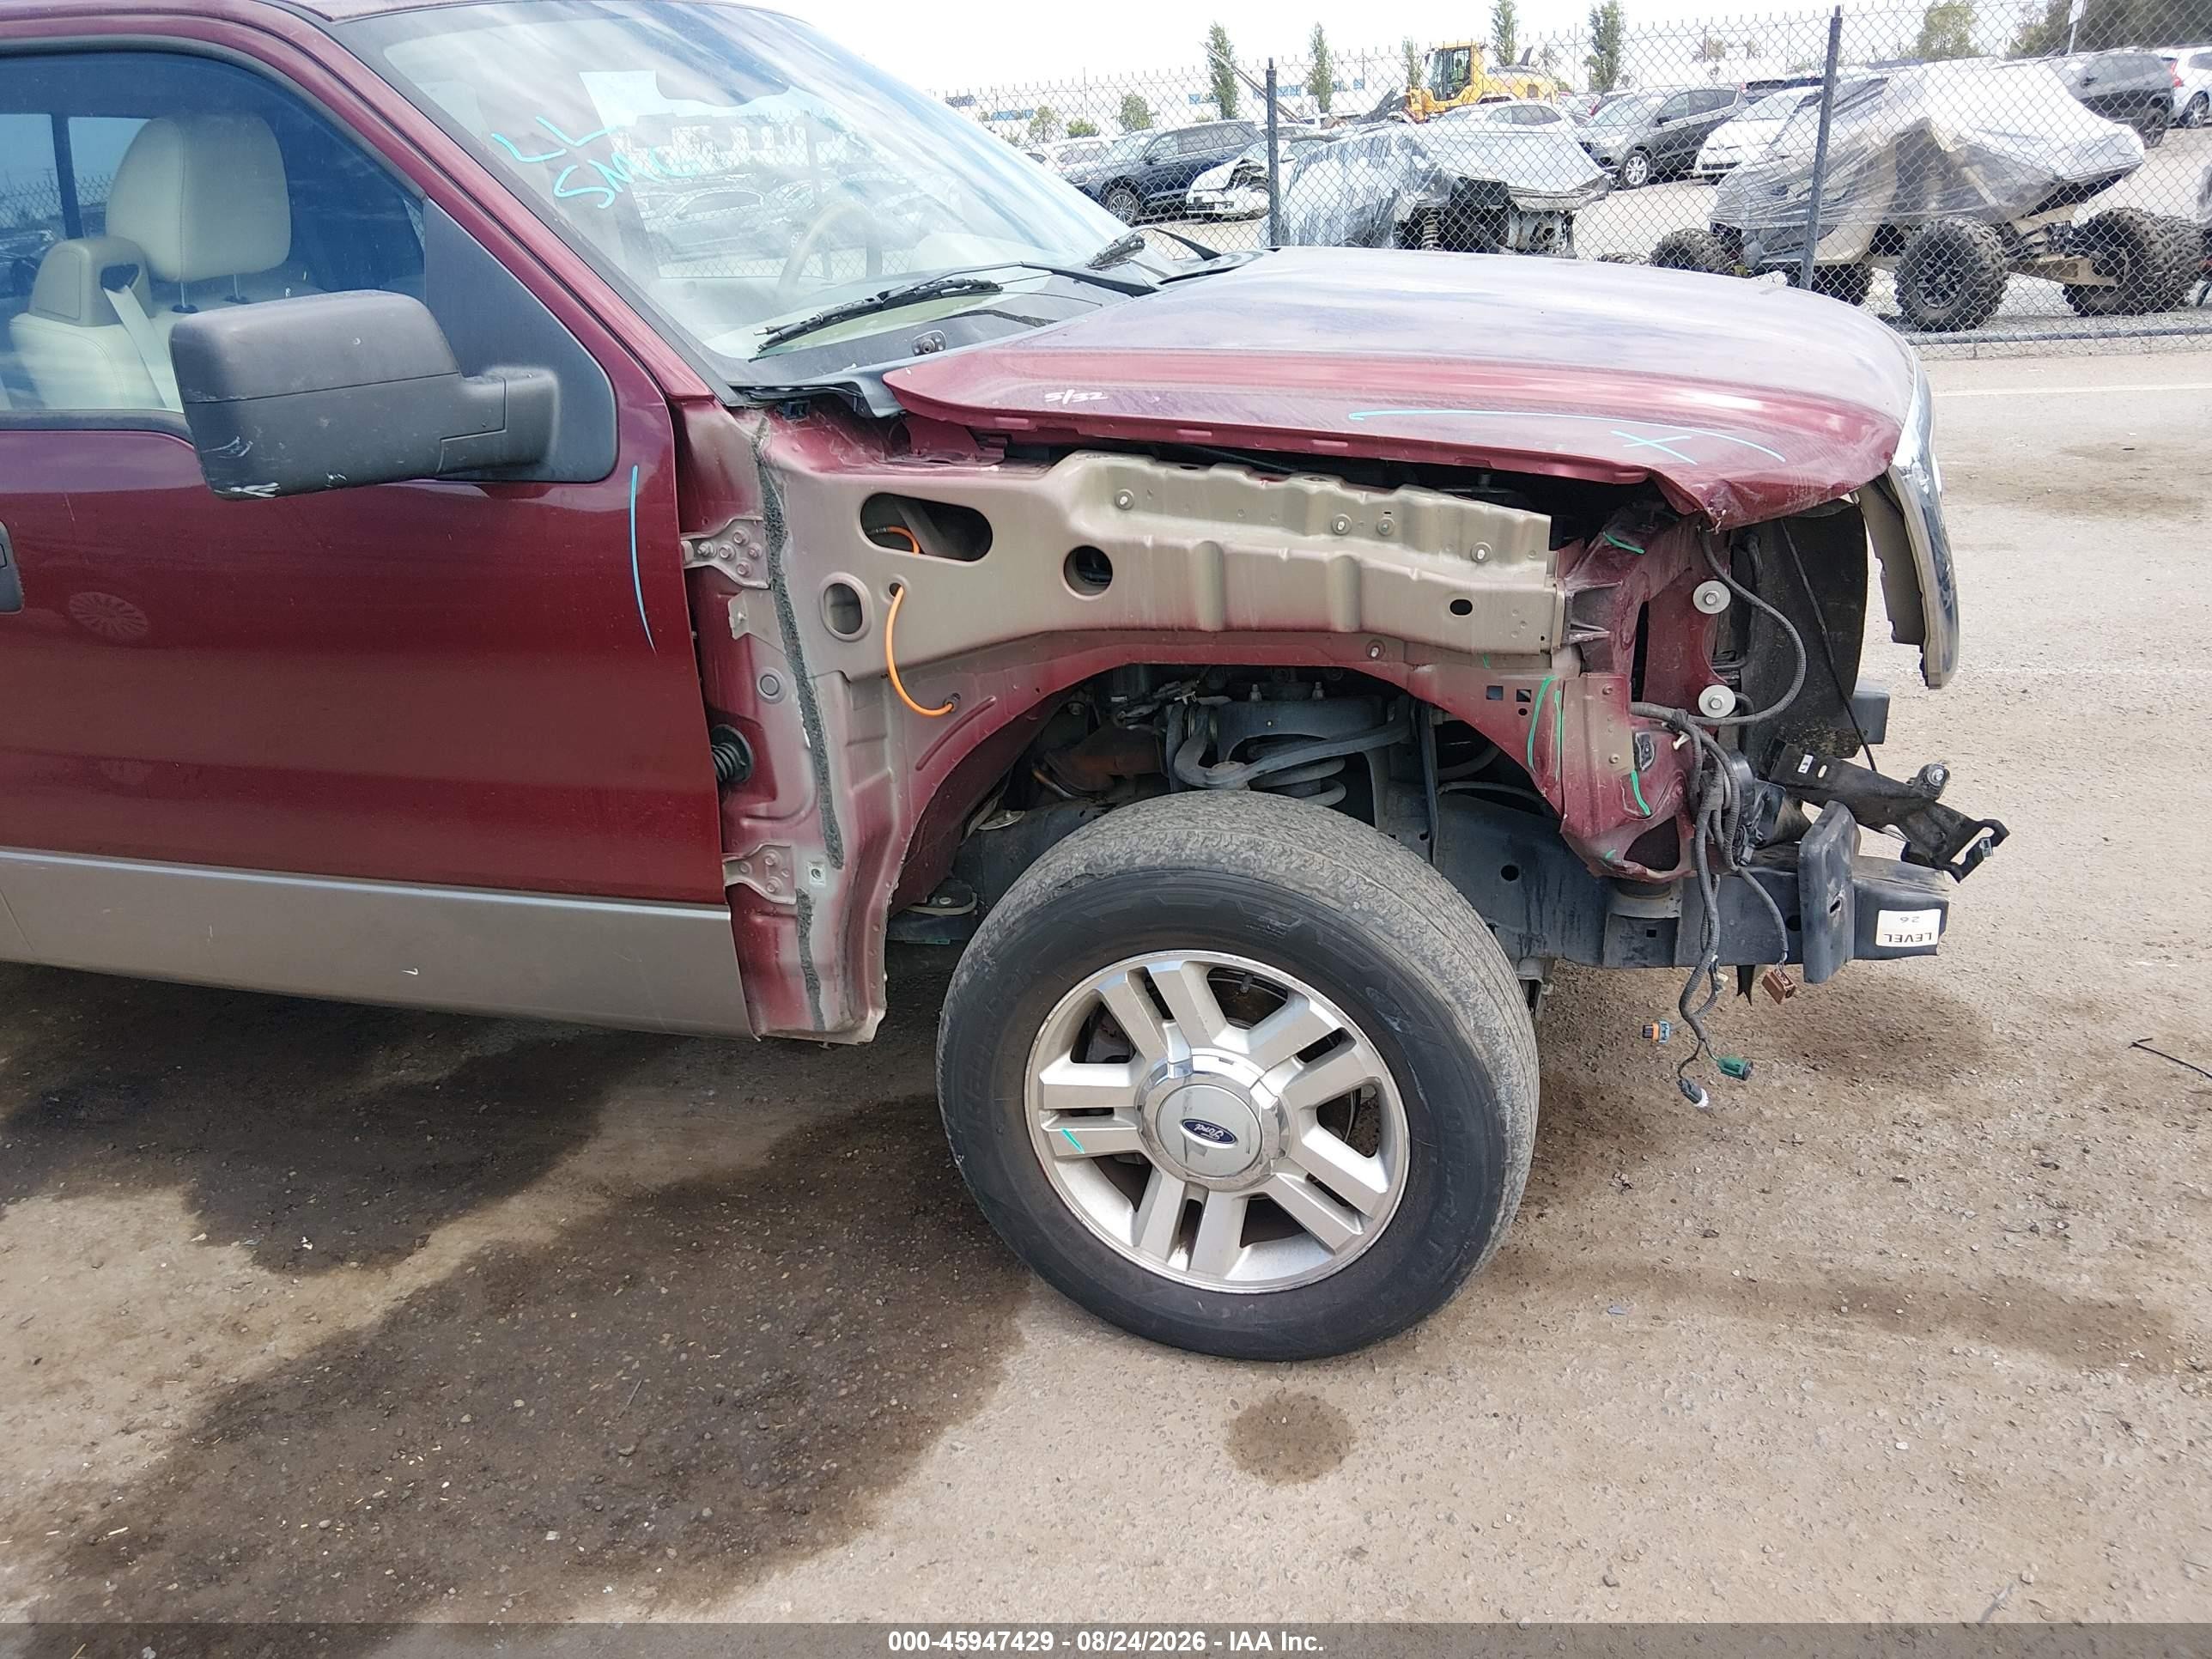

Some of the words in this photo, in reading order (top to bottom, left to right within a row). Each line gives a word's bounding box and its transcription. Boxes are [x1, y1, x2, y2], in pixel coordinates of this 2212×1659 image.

[1899, 915, 1920, 925] 26
[1883, 932, 1933, 944] LEVEL
[1194, 1122, 1225, 1140] Ford
